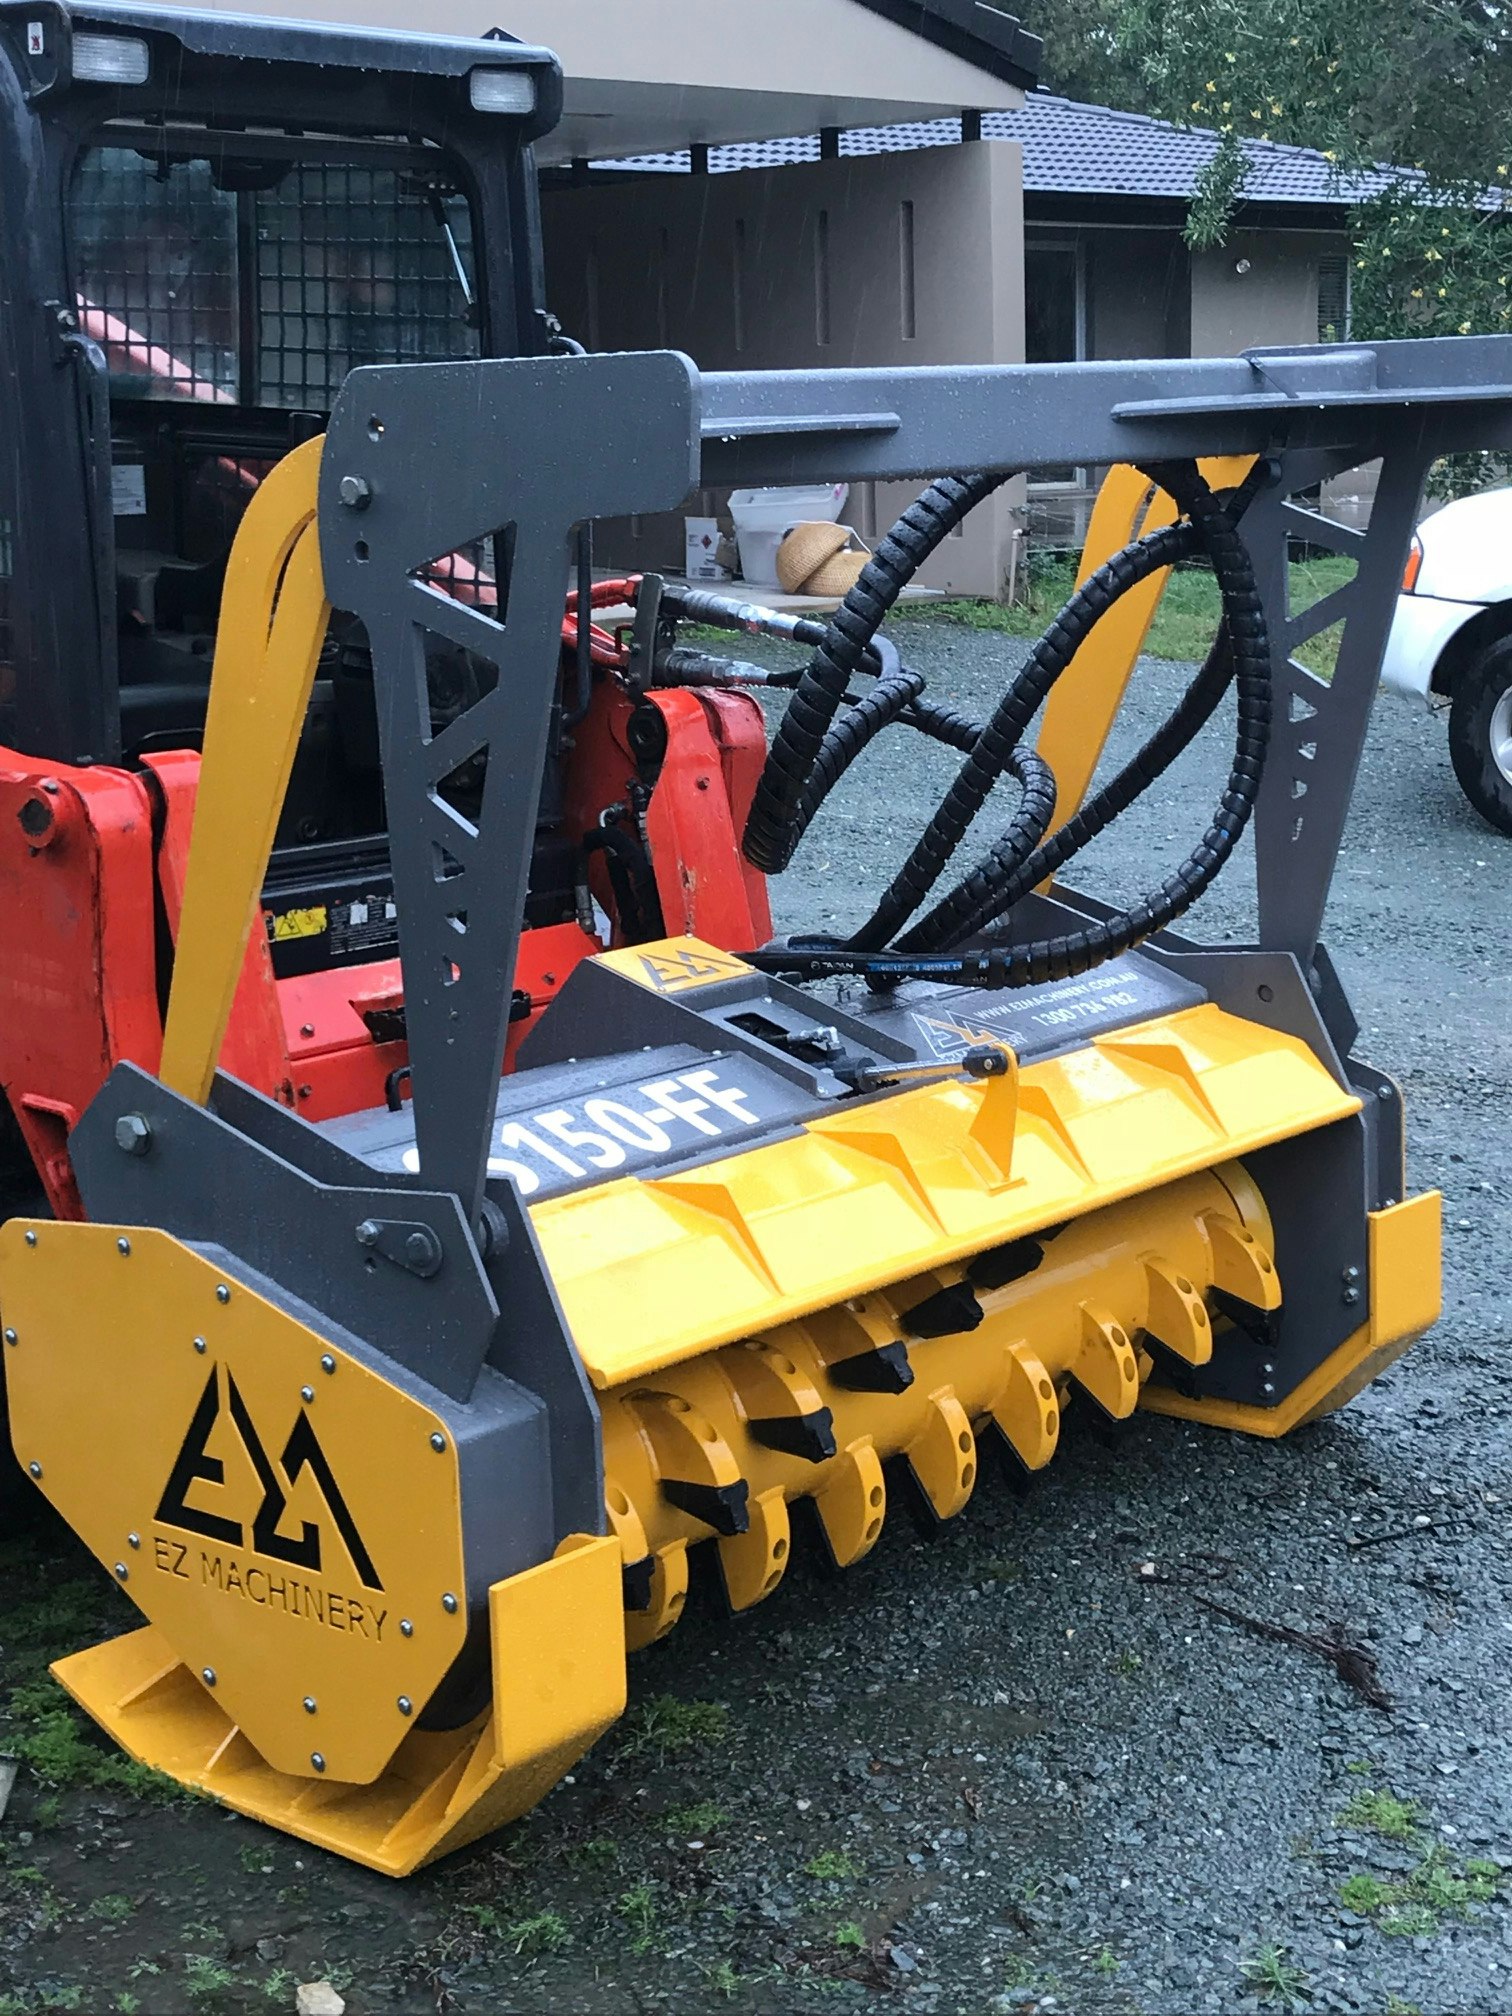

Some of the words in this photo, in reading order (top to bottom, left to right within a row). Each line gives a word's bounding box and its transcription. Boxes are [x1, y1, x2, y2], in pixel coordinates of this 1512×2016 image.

[1030, 1007, 1077, 1027] 1300
[1069, 999, 1108, 1017] 736
[153, 1536, 190, 1581] EZ
[201, 1551, 387, 1643] MACHINERY
